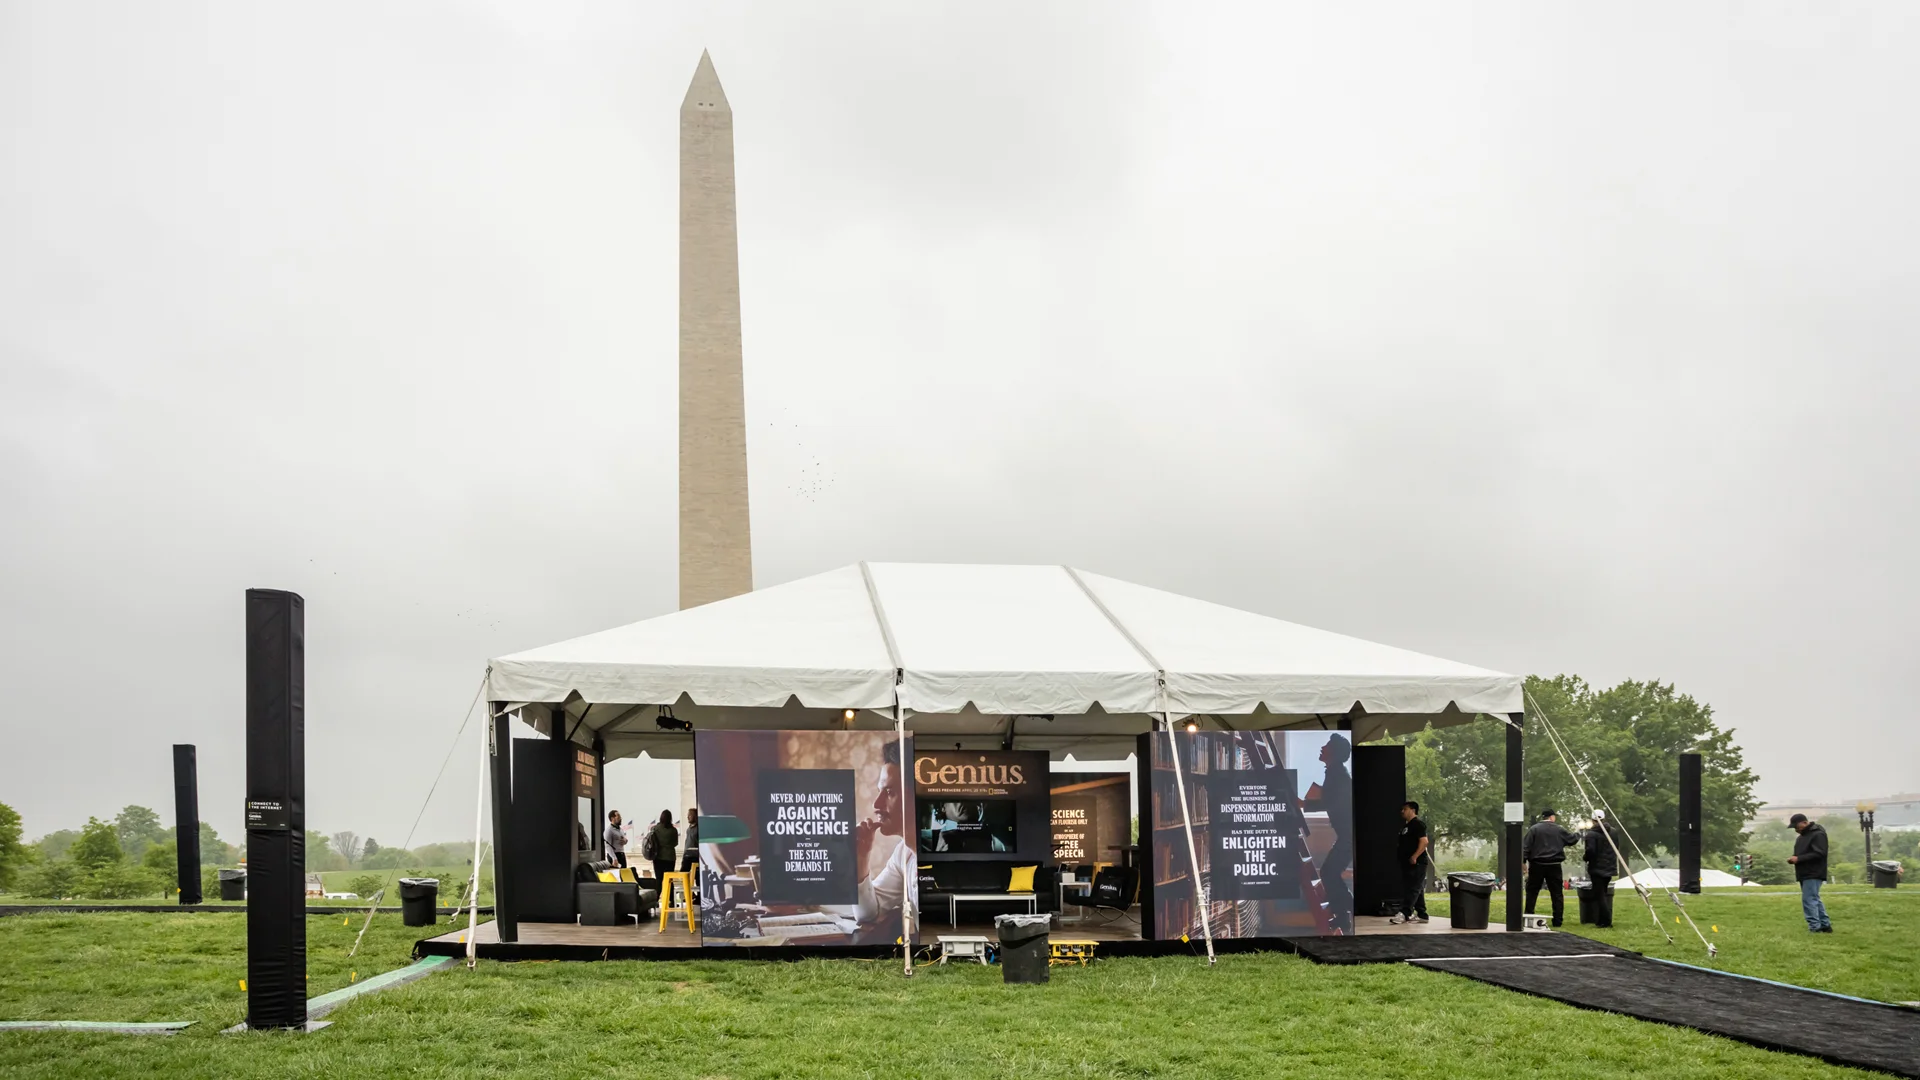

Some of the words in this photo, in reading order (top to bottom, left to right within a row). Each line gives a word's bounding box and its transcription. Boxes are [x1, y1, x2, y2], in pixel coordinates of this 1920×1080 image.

[770, 793, 794, 803] NEVER
[795, 793, 806, 803] DO
[807, 793, 843, 803] ANYTHING
[777, 806, 838, 820] AGAINST
[1221, 804, 1256, 812] DISPENSING
[1257, 803, 1287, 812] RELIABLE
[1052, 809, 1085, 819] SCIENCE
[1233, 813, 1274, 822] INFORMATION
[766, 821, 849, 835] CONSCIENCE
[1222, 836, 1286, 850] ENLIGHTEN
[788, 849, 804, 860] THE
[805, 849, 829, 860] STATE
[1053, 849, 1085, 858] SPEECH.
[1244, 850, 1266, 862] THE
[785, 861, 822, 872] DEMANDS
[823, 861, 833, 872] IT.
[1233, 863, 1279, 876] PUBLIC.
